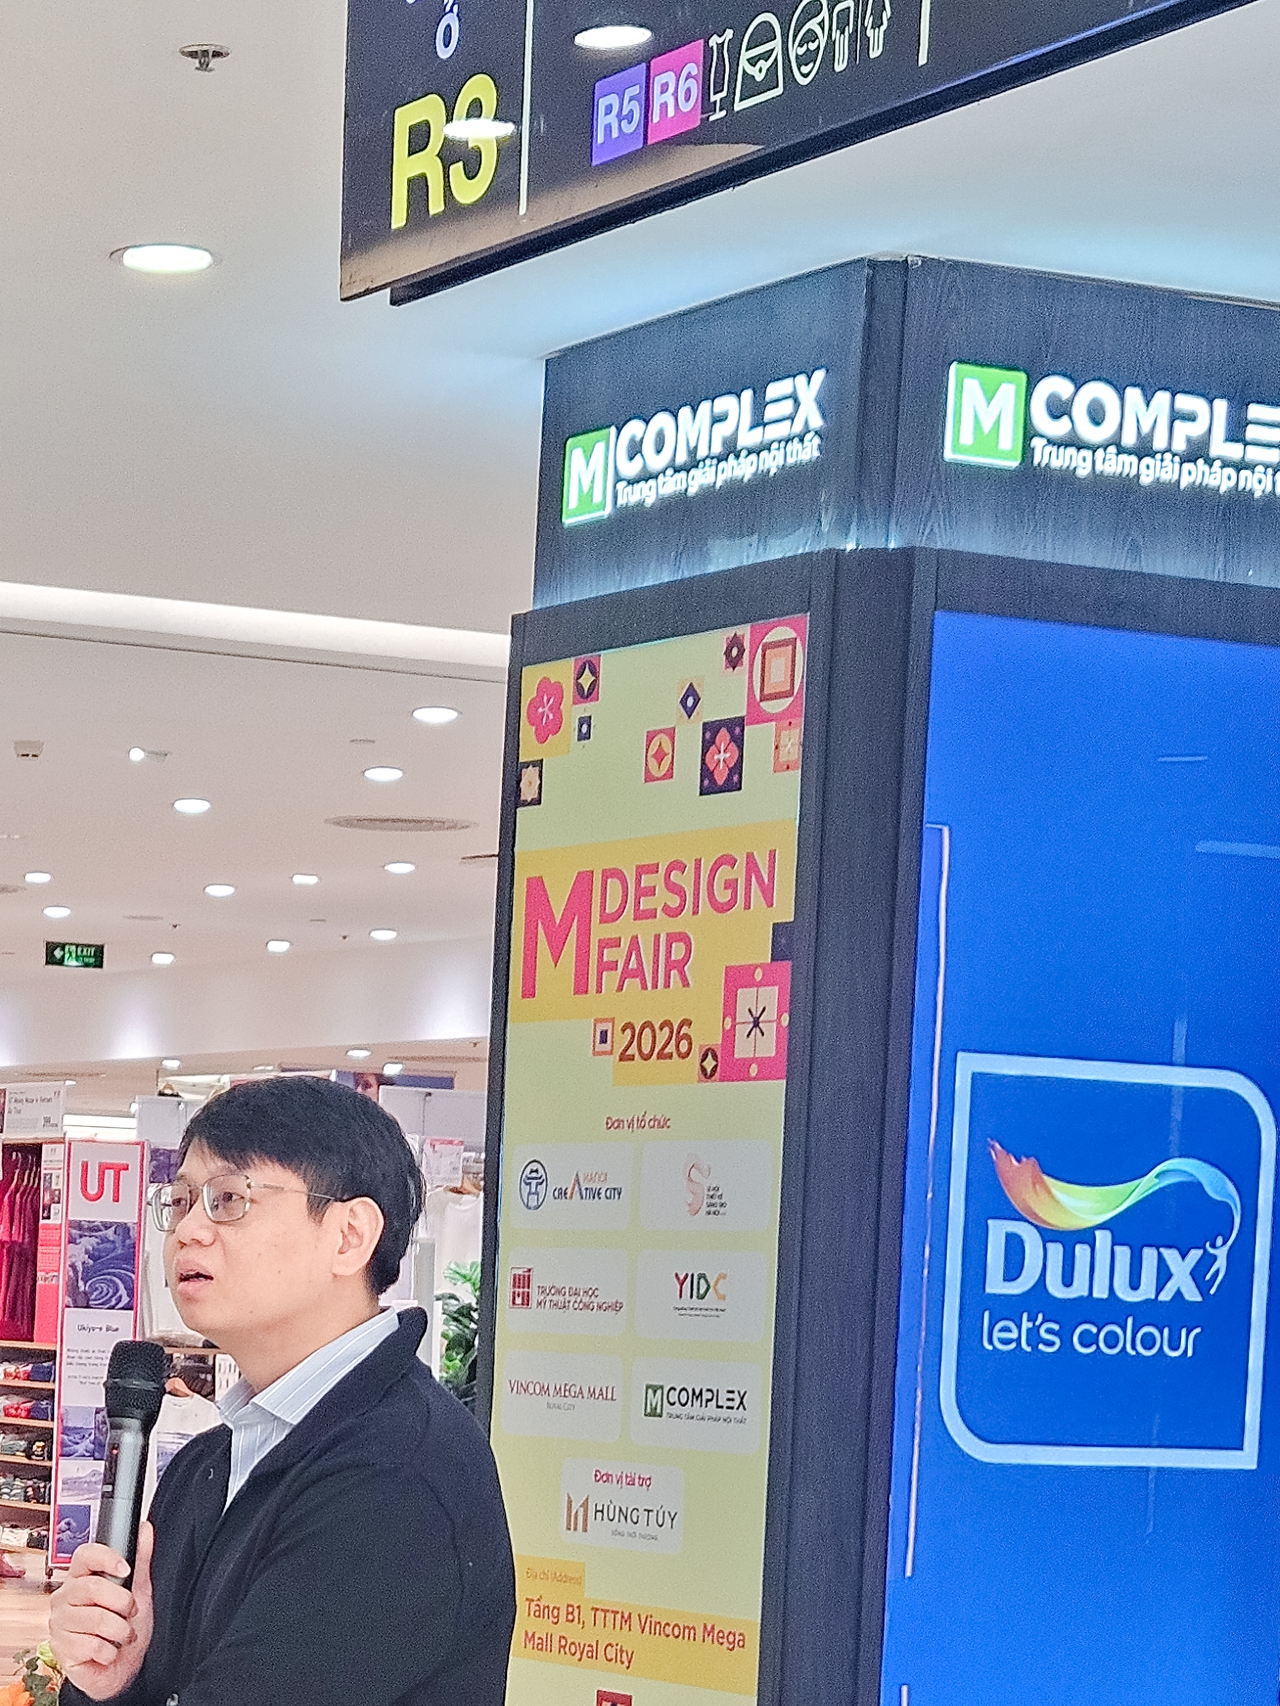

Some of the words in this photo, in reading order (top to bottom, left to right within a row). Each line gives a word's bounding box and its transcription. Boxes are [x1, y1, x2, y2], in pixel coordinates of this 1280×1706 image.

[596, 84, 642, 145] R5
[651, 63, 699, 123] R6
[391, 73, 498, 230] R3
[959, 377, 1016, 450] M
[568, 441, 606, 510] M
[616, 367, 827, 477] COMPLEX
[616, 480, 657, 508] Trung
[657, 468, 687, 495] tâm
[716, 446, 757, 490] pháp
[1030, 437, 1093, 478] Trung
[1093, 445, 1138, 476] tâm
[1139, 451, 1180, 486] giải
[1179, 459, 1237, 494] pháp
[1237, 464, 1273, 499] nội
[521, 869, 594, 999] M
[598, 849, 778, 925] DESIGN
[595, 931, 693, 995] FAIR
[618, 1018, 694, 1063] 2026
[605, 1116, 625, 1130] Đơn
[636, 1110, 648, 1129] tổ
[648, 1114, 671, 1130] chức
[80, 1160, 129, 1203] UT
[605, 1187, 622, 1200] CITY
[984, 1218, 1204, 1302] Dulux
[674, 1272, 728, 1301] YIDC
[981, 1309, 1061, 1353] let's
[1072, 1316, 1202, 1357] colour
[508, 1379, 551, 1398] VINCOM
[552, 1382, 585, 1400] MEGA
[586, 1384, 617, 1401] MALL
[646, 1386, 662, 1417] M
[665, 1386, 748, 1412] COMPLEX
[594, 1469, 614, 1484] Đơn
[615, 1471, 623, 1489] vị
[624, 1472, 636, 1487] tài
[638, 1473, 653, 1491] trợ
[593, 1499, 640, 1525] HÙNG
[643, 1504, 678, 1530] TÚY
[525, 1595, 560, 1626] Tầng
[565, 1603, 585, 1629] B1,
[591, 1606, 632, 1632] TTTM
[637, 1613, 696, 1642] Vincom
[702, 1623, 746, 1652] Mega
[523, 1630, 553, 1654] Mall
[558, 1635, 599, 1662] Royal
[603, 1642, 634, 1669] City
